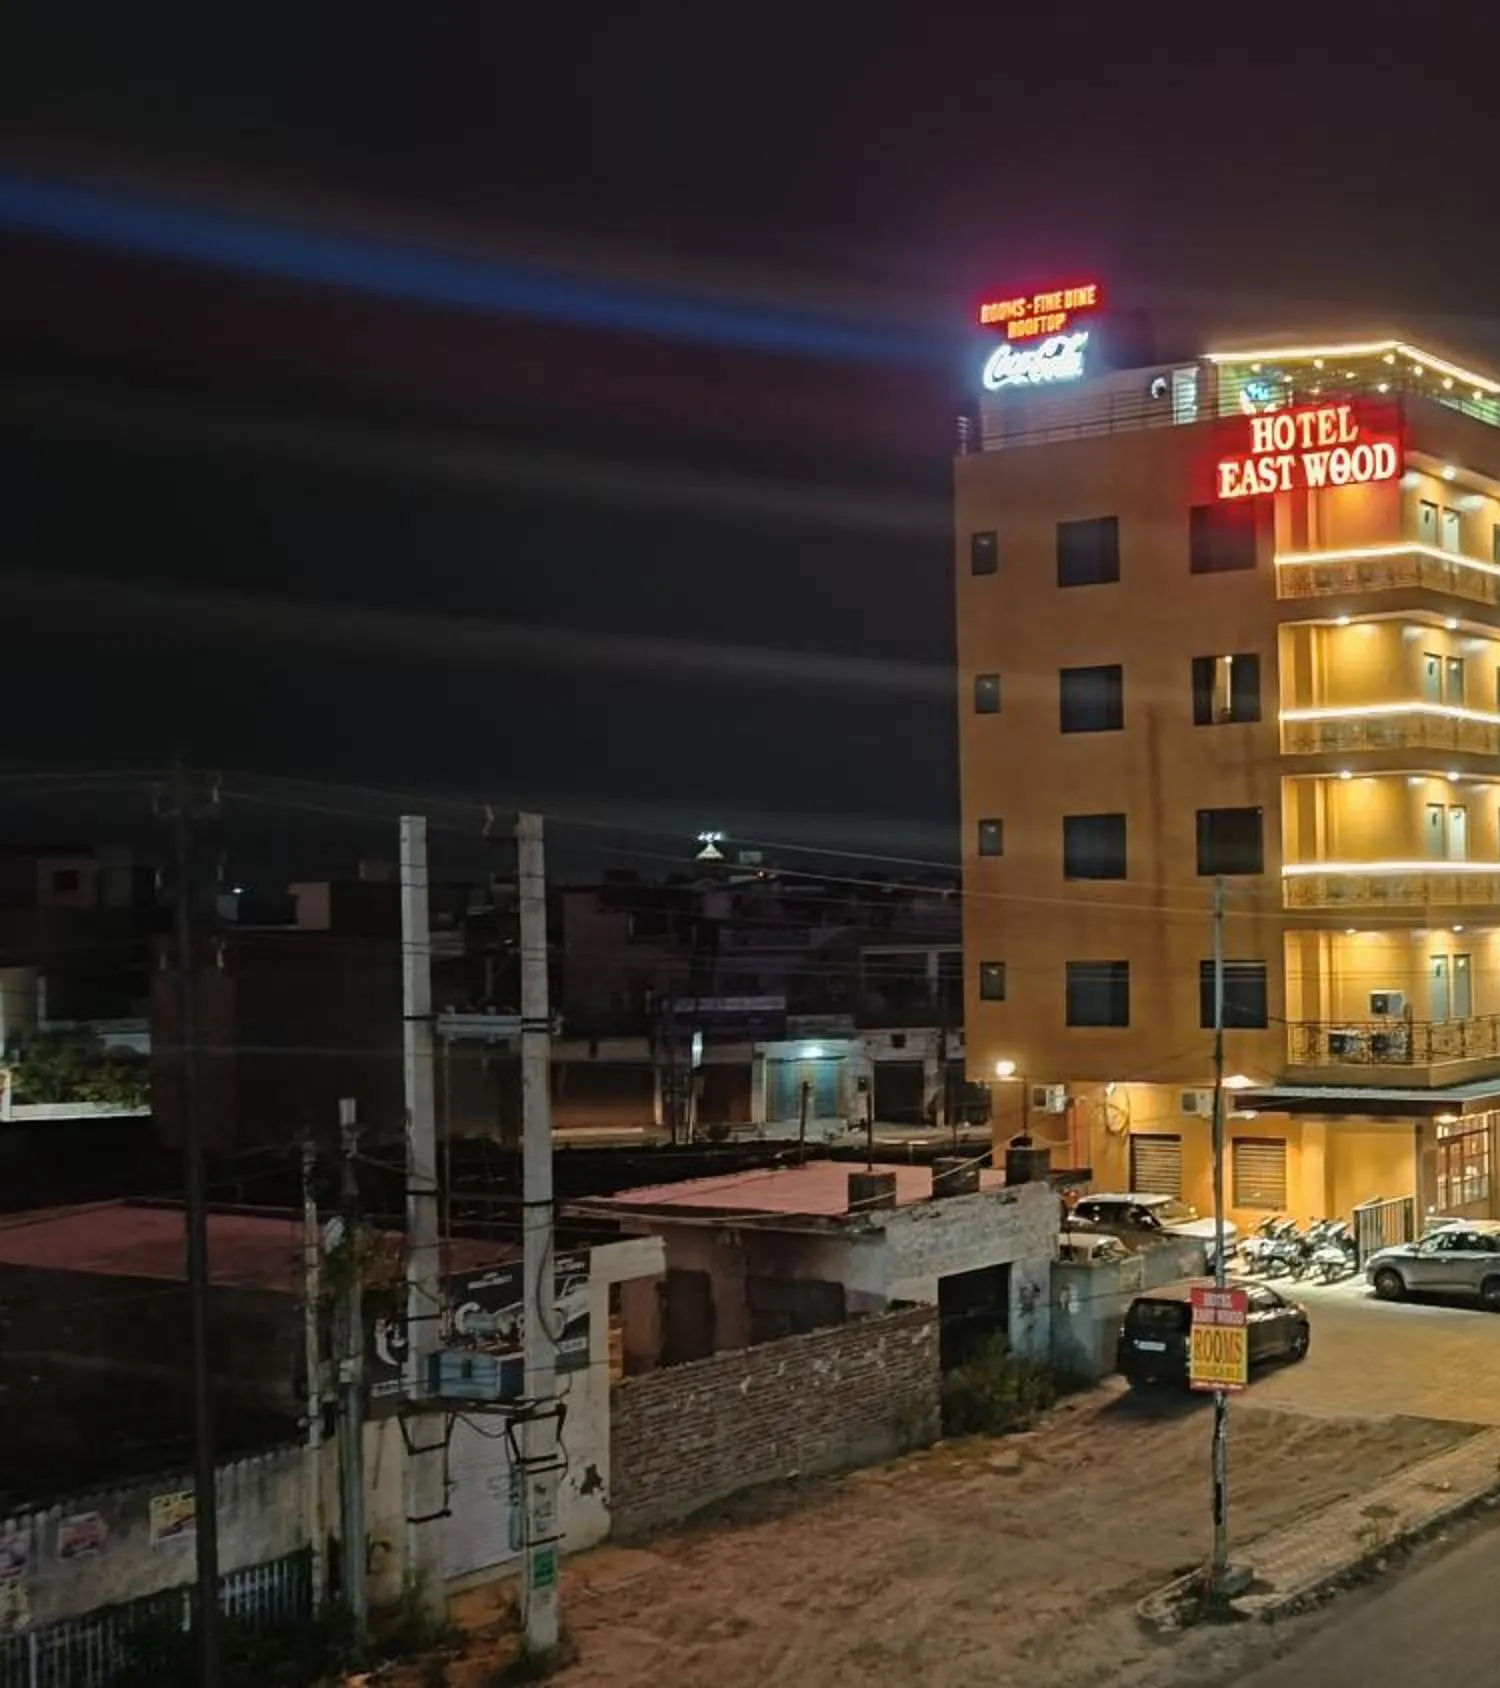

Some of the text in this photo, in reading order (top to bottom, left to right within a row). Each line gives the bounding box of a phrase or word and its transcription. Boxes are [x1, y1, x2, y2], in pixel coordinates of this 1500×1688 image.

[1250, 405, 1359, 454] HOTEL
[1217, 442, 1397, 499] EAST WOOD
[1194, 1329, 1244, 1364] ROOMS
